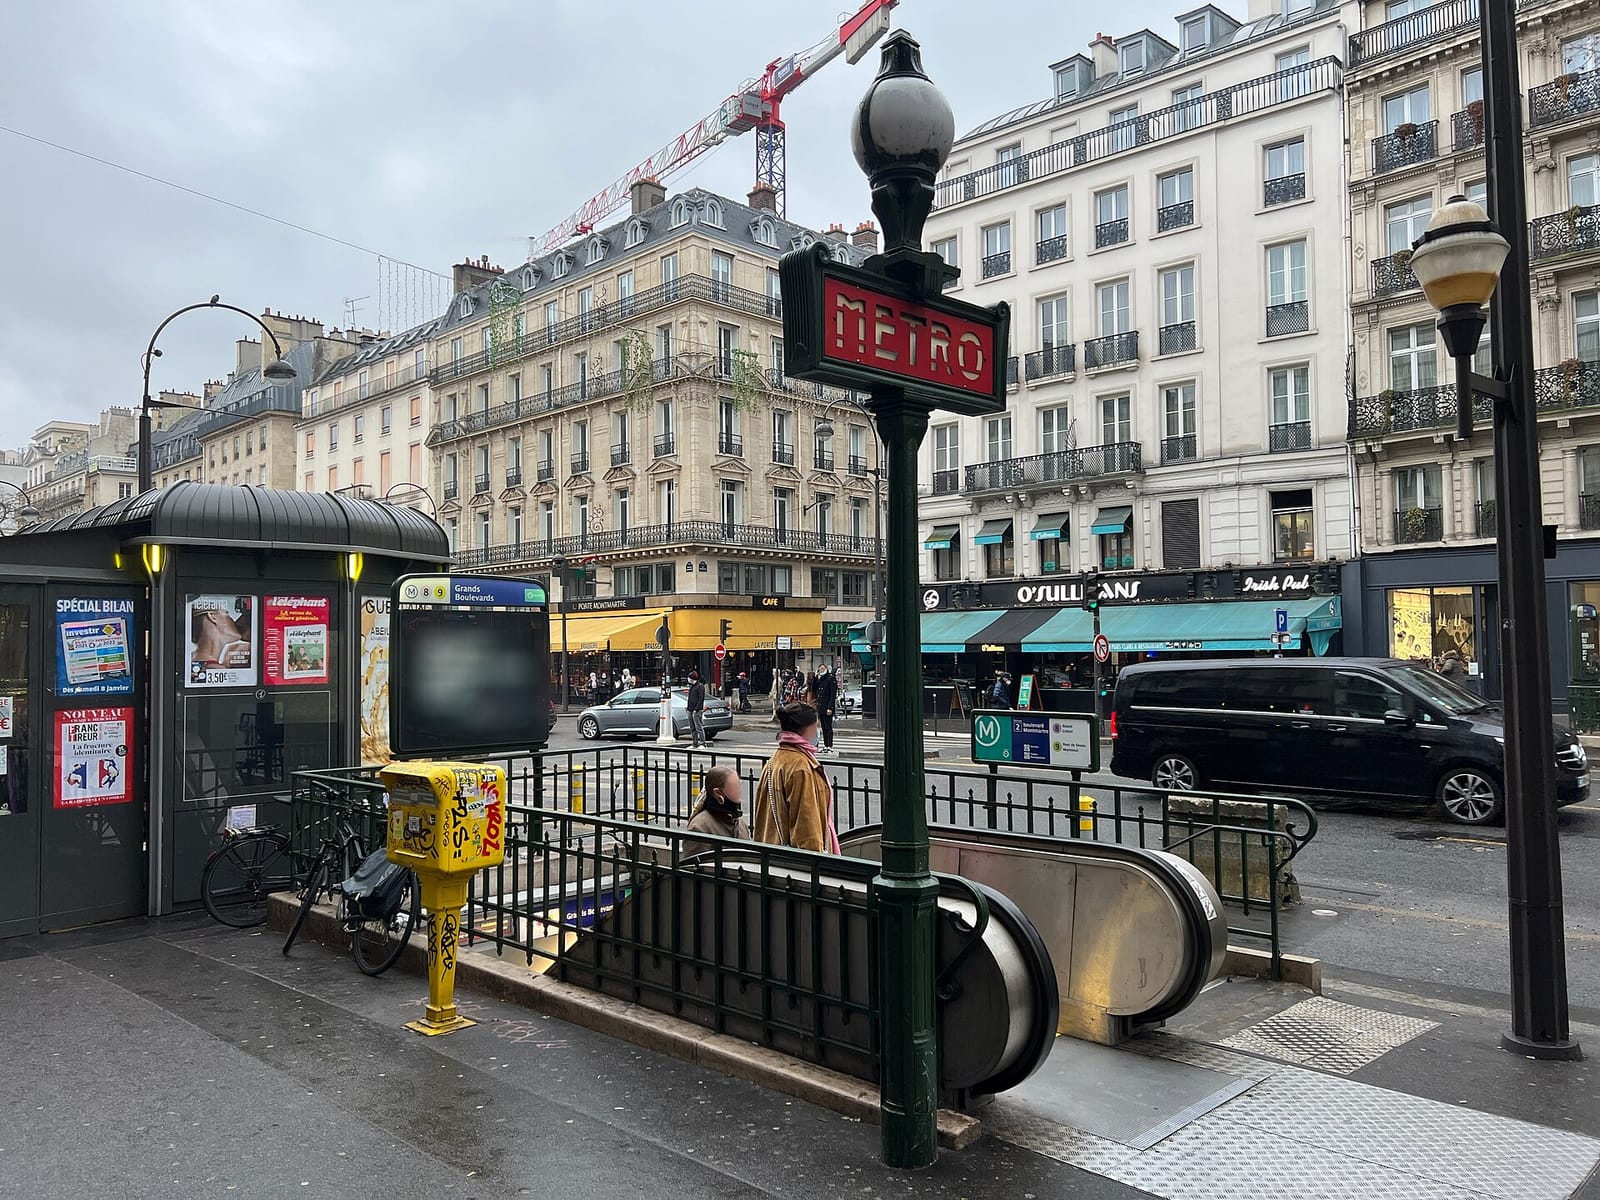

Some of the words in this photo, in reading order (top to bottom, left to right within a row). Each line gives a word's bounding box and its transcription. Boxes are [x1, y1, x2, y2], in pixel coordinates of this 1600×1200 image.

[836, 293, 983, 381] METRO
[1242, 576, 1279, 592] Irish
[1282, 575, 1310, 590] Pub
[424, 588, 429, 596] 8
[438, 588, 443, 597] 9
[1017, 580, 1141, 602] O'SULLIANS
[455, 594, 494, 602] Boulevards
[56, 598, 102, 612] SPÉCIAL
[102, 600, 134, 612] BILAN
[1279, 614, 1285, 628] P
[66, 628, 100, 637] investir
[208, 672, 228, 684] 3,50€
[62, 708, 126, 720] NOUVEAU
[68, 723, 98, 734] FRANC
[979, 720, 994, 740] M
[68, 732, 98, 742] TIREUR
